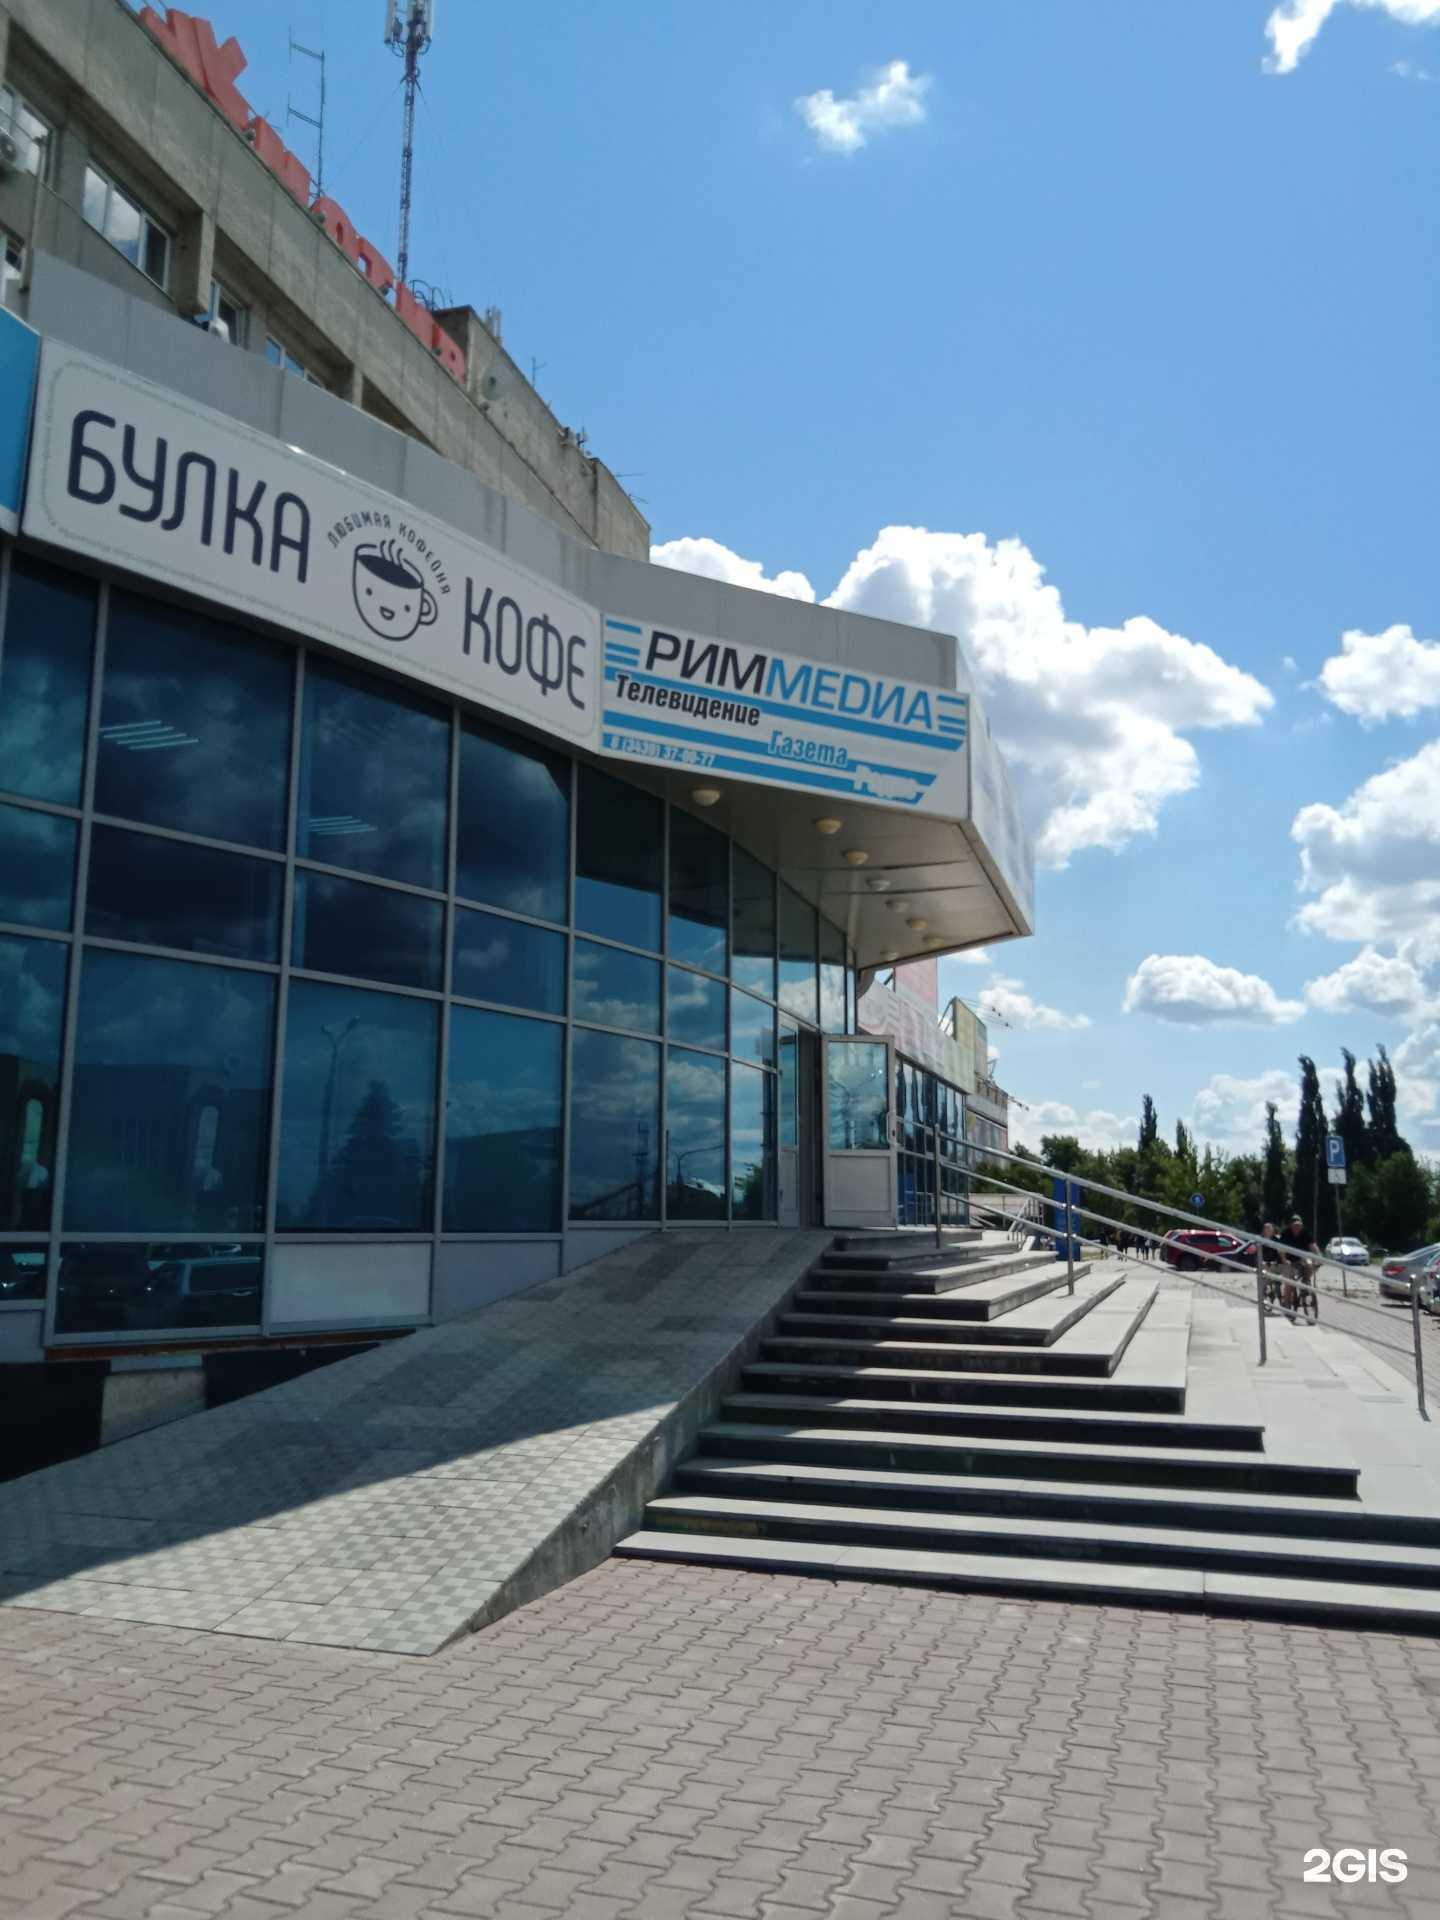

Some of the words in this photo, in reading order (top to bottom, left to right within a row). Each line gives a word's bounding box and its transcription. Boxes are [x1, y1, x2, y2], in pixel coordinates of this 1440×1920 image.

[327, 511, 391, 548] ЛЮБИМАЯ
[67, 410, 310, 584] БУЛКА
[463, 576, 586, 711] КОФЕ
[616, 674, 760, 726] Телевидение
[769, 730, 848, 767] Газета
[1329, 1139, 1339, 1162] P
